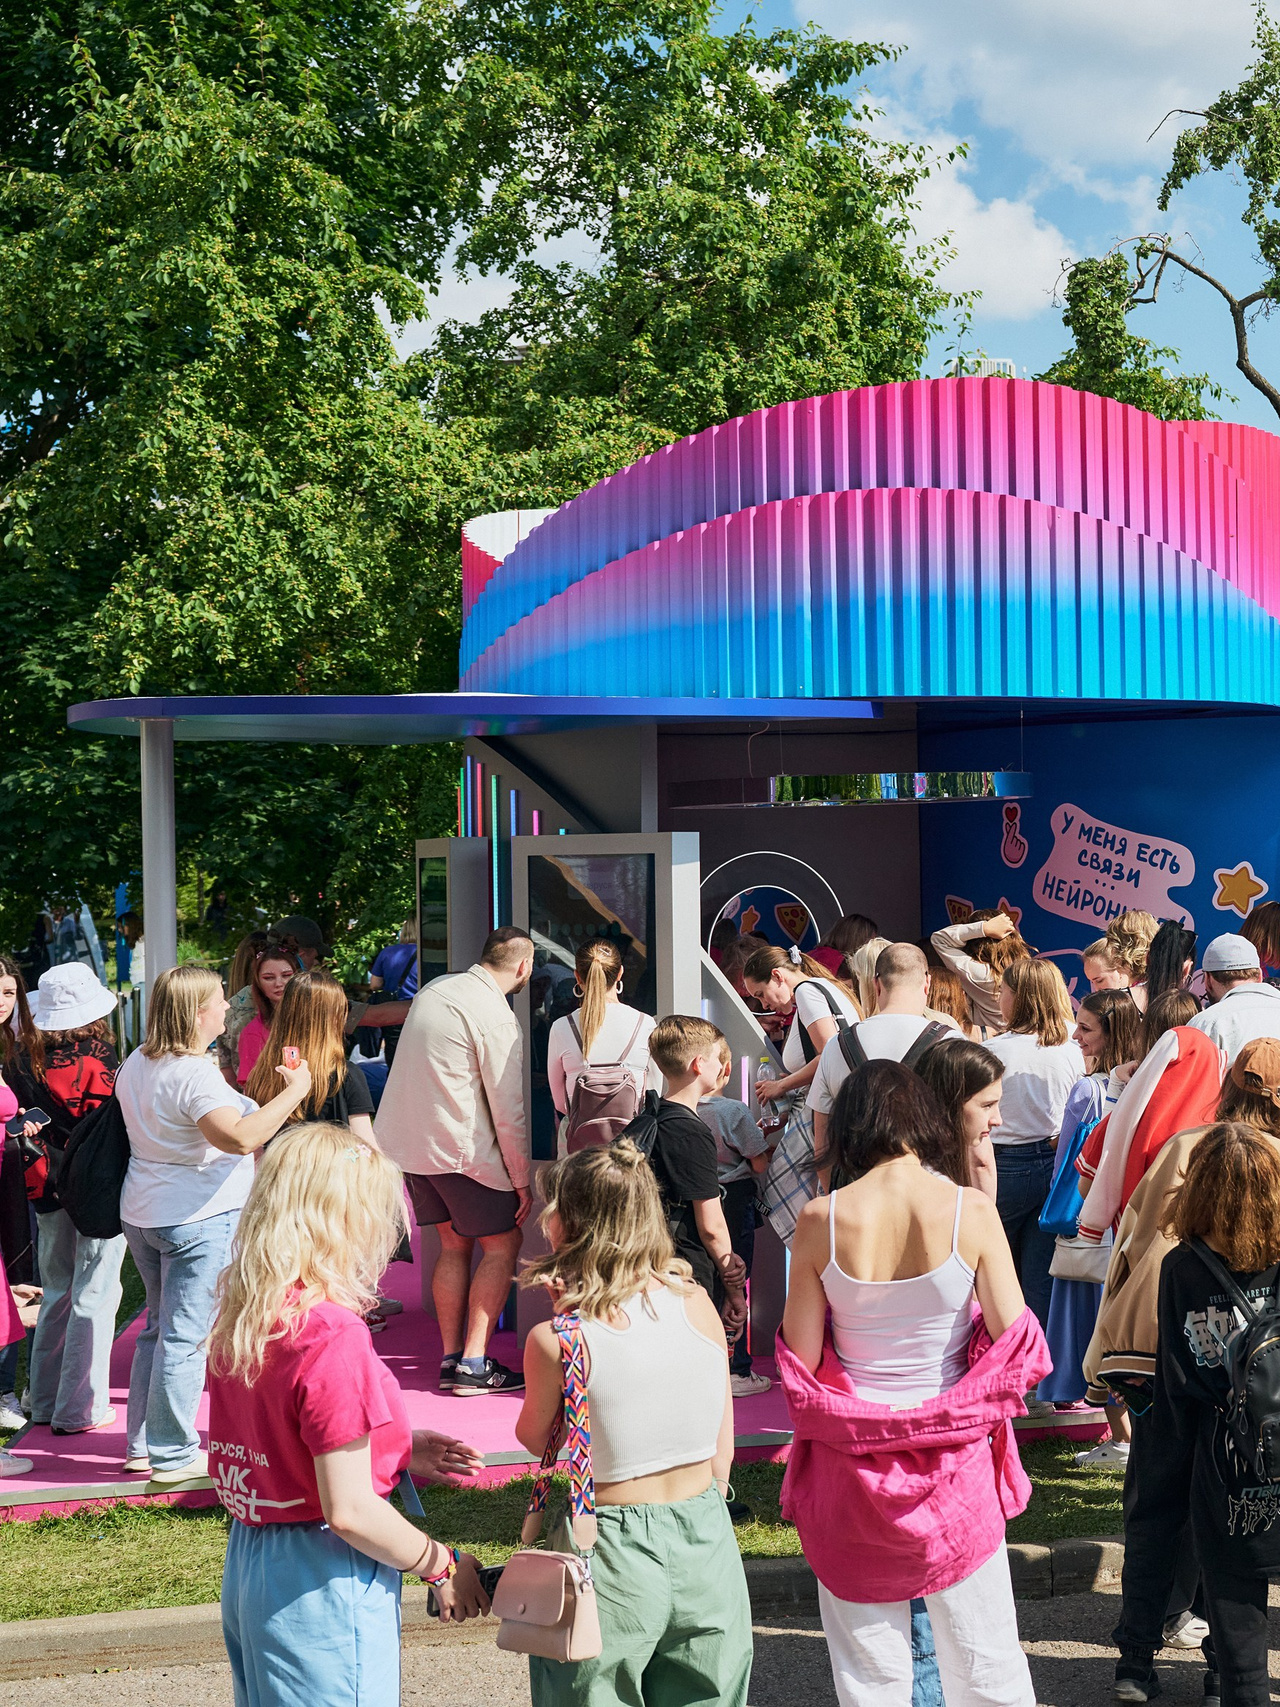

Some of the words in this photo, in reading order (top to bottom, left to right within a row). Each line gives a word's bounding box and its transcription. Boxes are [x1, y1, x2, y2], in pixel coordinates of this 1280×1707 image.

[1061, 811, 1075, 834] У
[1077, 822, 1128, 857] МЕНЯ
[1136, 842, 1181, 875] ЕСТЬ
[1077, 848, 1141, 889] СВЯЗИ
[209, 1440, 247, 1463] РУСЯ,
[218, 1462, 252, 1494] VK
